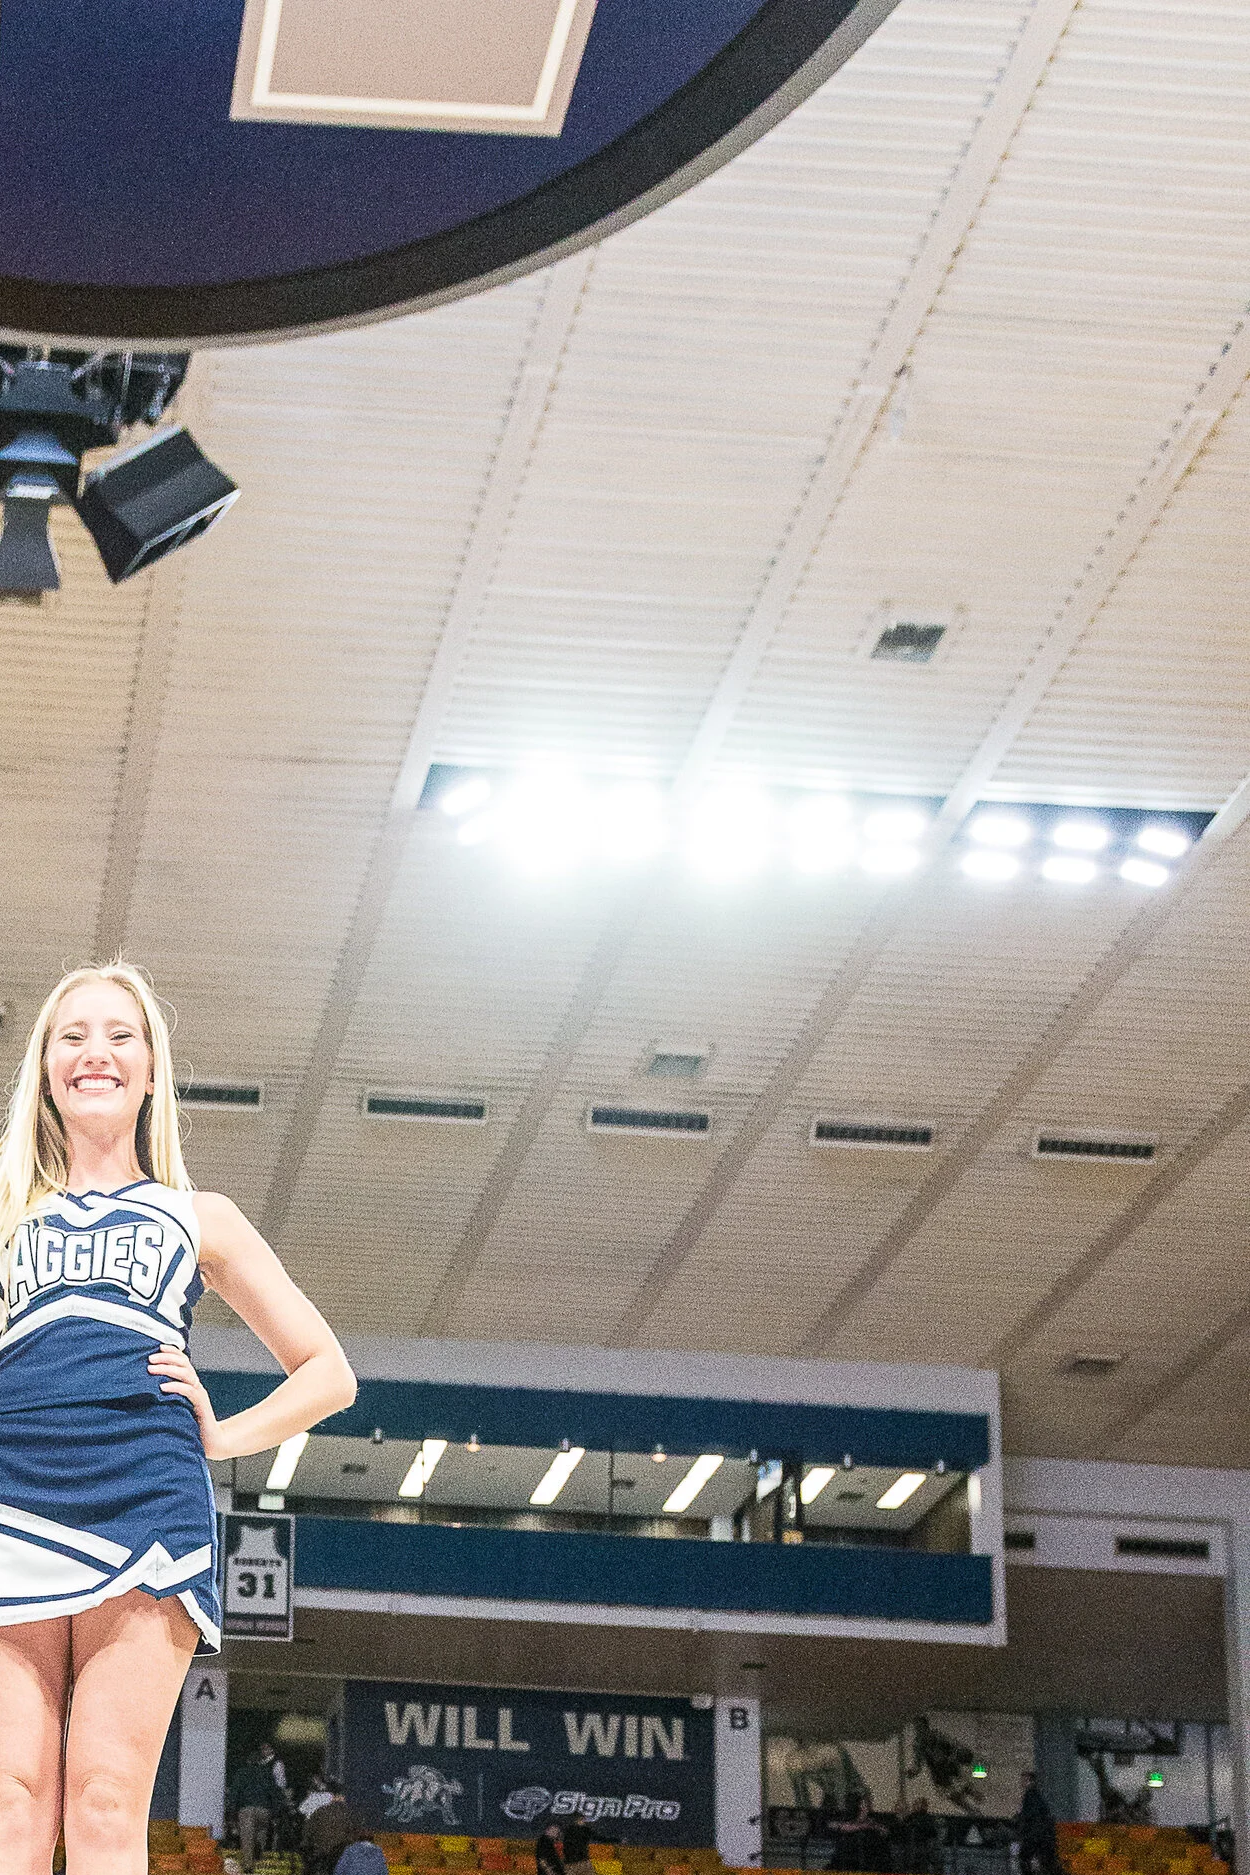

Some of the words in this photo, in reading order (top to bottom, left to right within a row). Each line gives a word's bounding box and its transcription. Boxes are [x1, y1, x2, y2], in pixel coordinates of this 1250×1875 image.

[9, 1222, 165, 1308] AGGIES
[236, 1571, 276, 1600] 31
[196, 1677, 216, 1700] A
[384, 1700, 531, 1753] WILL
[563, 1710, 686, 1761] WIN
[729, 1707, 750, 1732] B
